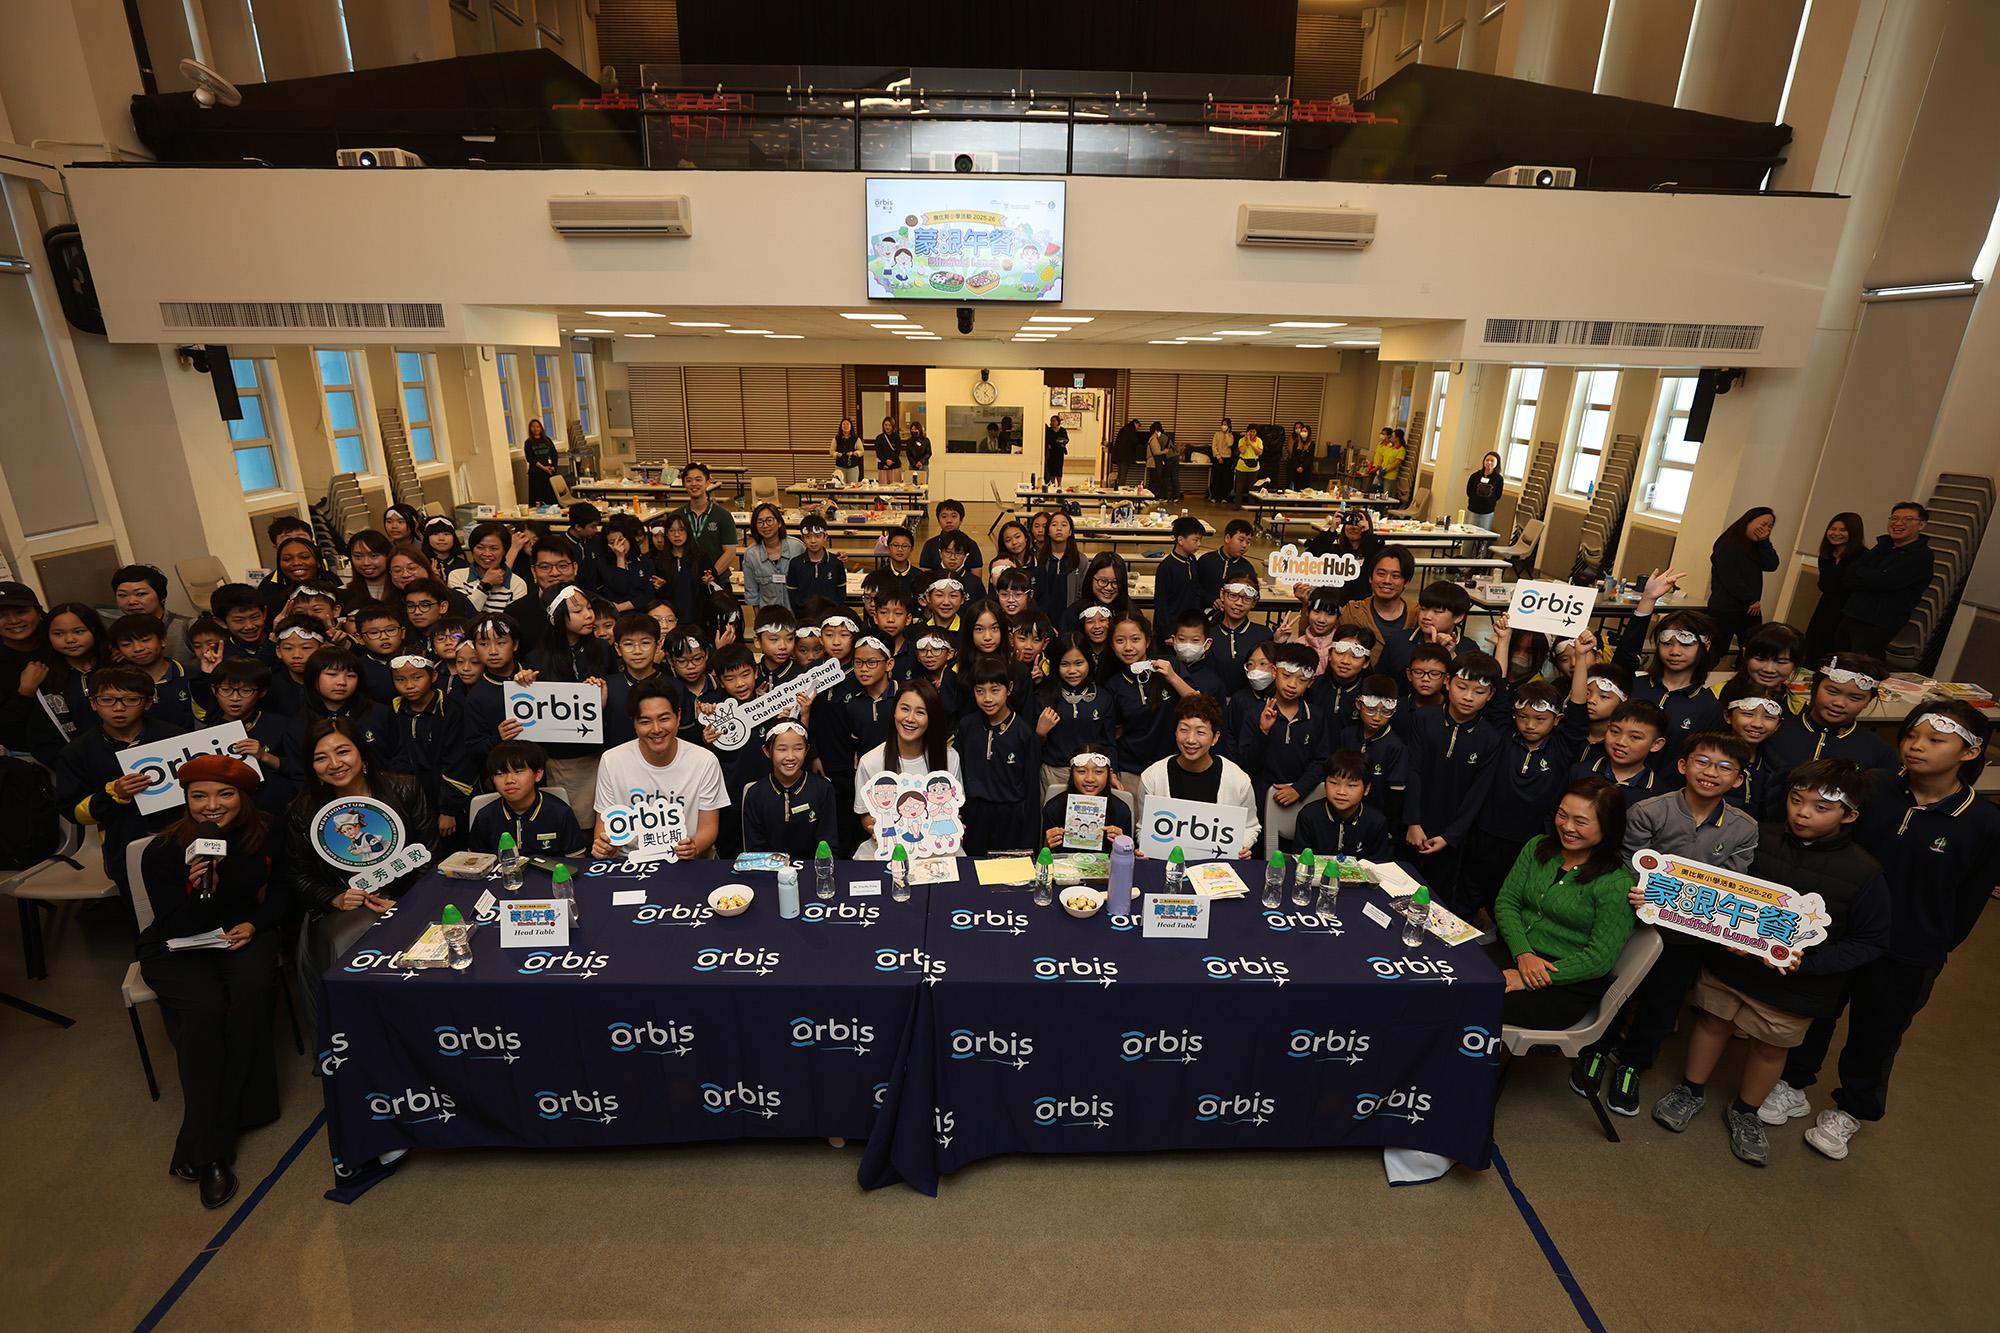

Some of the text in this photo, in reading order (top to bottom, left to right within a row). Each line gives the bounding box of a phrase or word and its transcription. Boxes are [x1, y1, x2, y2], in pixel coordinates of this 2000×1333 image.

[1520, 592, 1584, 616] orbis
[744, 662, 837, 715] Rusy and Purviz Shroff
[512, 694, 597, 722] orbis
[752, 697, 795, 721] Charitable
[318, 803, 366, 831] MENTHOLATUM
[609, 804, 681, 834] orbis
[1154, 815, 1235, 845] orbis
[355, 848, 425, 890] 曼秀雷敦
[586, 859, 660, 875] orbis
[1738, 884, 1773, 900] 2025-26
[636, 903, 714, 922] orbis
[803, 902, 880, 922] orbis
[952, 909, 1029, 928] orbis
[1643, 872, 1801, 947] 蒙眼午餐
[1658, 908, 1769, 951] Blindfold Lunch
[523, 950, 610, 970] orbis
[696, 947, 780, 968] orbis
[1034, 956, 1119, 976] orbis
[1205, 956, 1290, 976] orbis
[1371, 955, 1454, 976] orbis
[437, 1025, 522, 1053] orbis
[610, 1019, 695, 1048] orbis
[792, 1017, 875, 1045] orbis
[951, 1030, 1034, 1057] orbis
[1122, 1029, 1203, 1057] orbis
[1290, 1029, 1371, 1053] orbis
[369, 1086, 457, 1116] orbis
[538, 1090, 620, 1115] orbis
[703, 1081, 782, 1109] orbis
[1035, 1094, 1114, 1121] orbis
[1197, 1091, 1276, 1117] orbis
[1356, 1086, 1432, 1116] orbis
